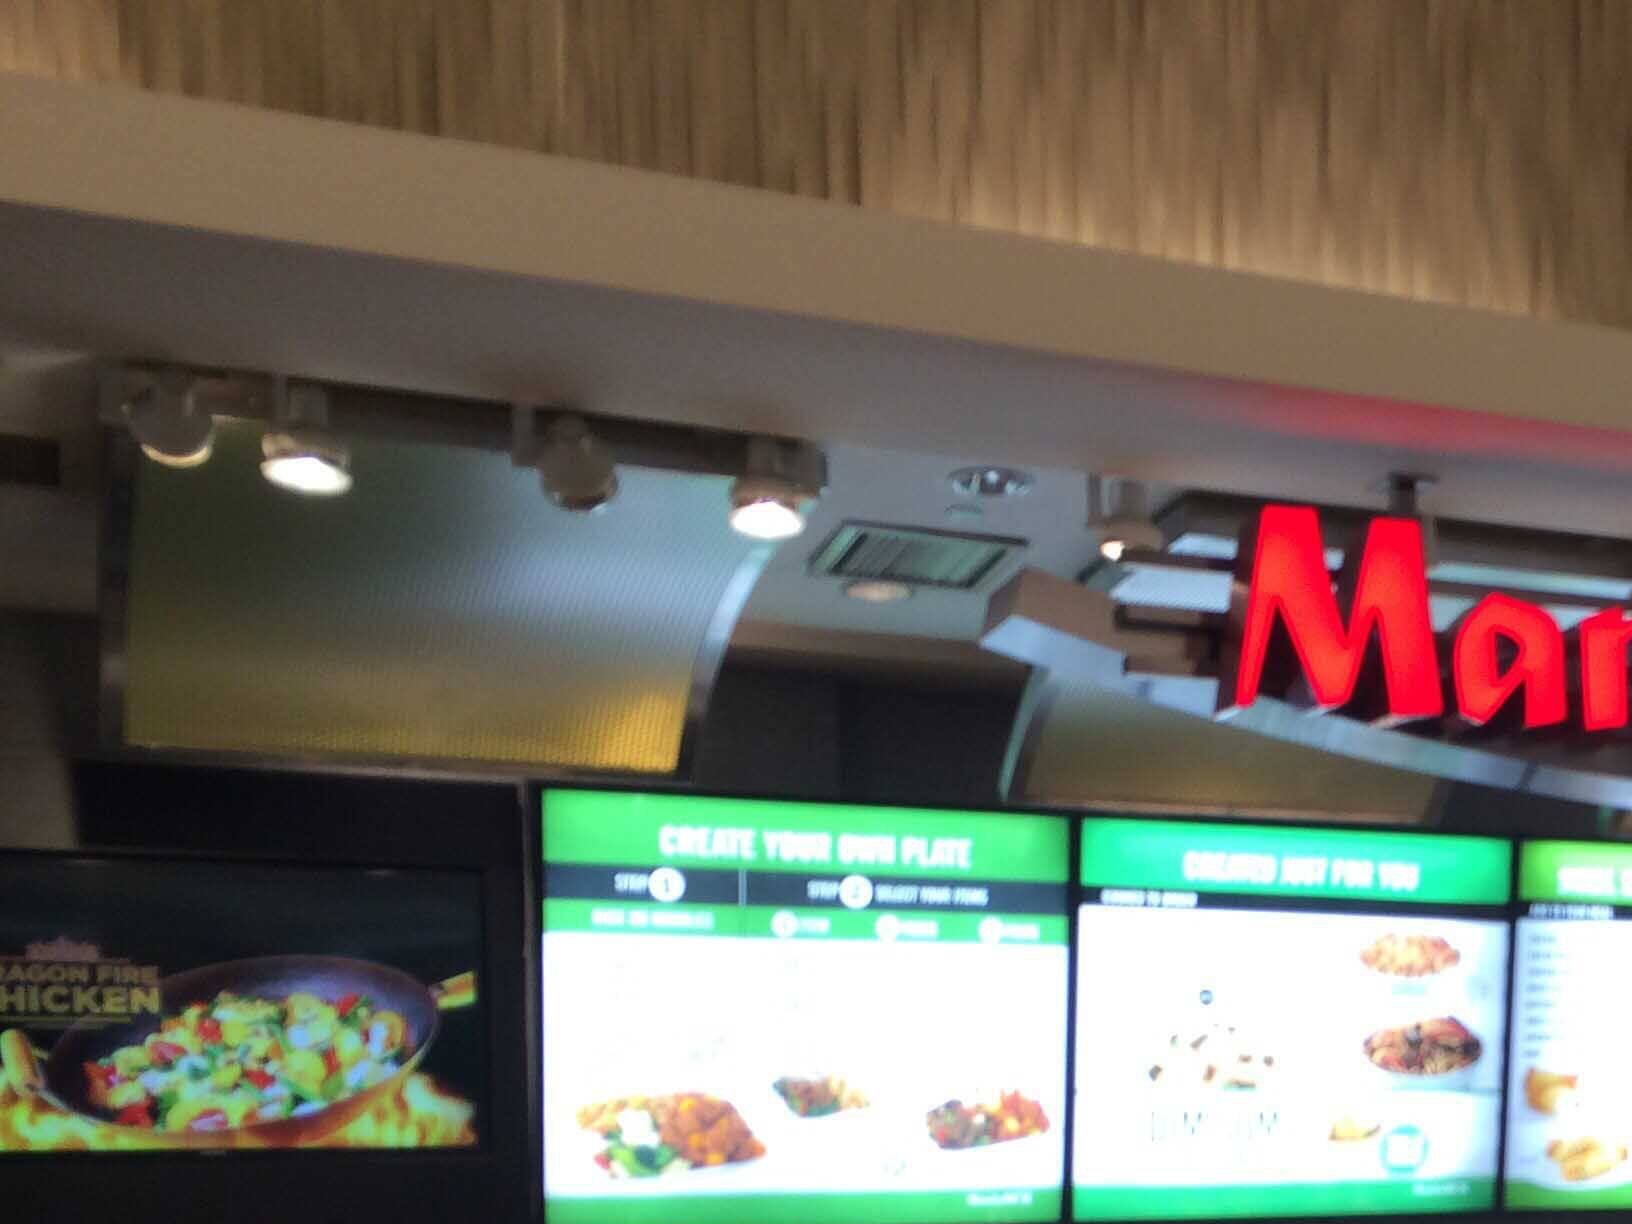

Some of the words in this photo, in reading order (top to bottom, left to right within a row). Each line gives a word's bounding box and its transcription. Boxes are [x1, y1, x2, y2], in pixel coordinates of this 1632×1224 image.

[659, 824, 757, 860] CREATE
[762, 829, 832, 864] YOUR
[899, 836, 973, 870] PLATE
[0, 985, 161, 1014] HICKEN
